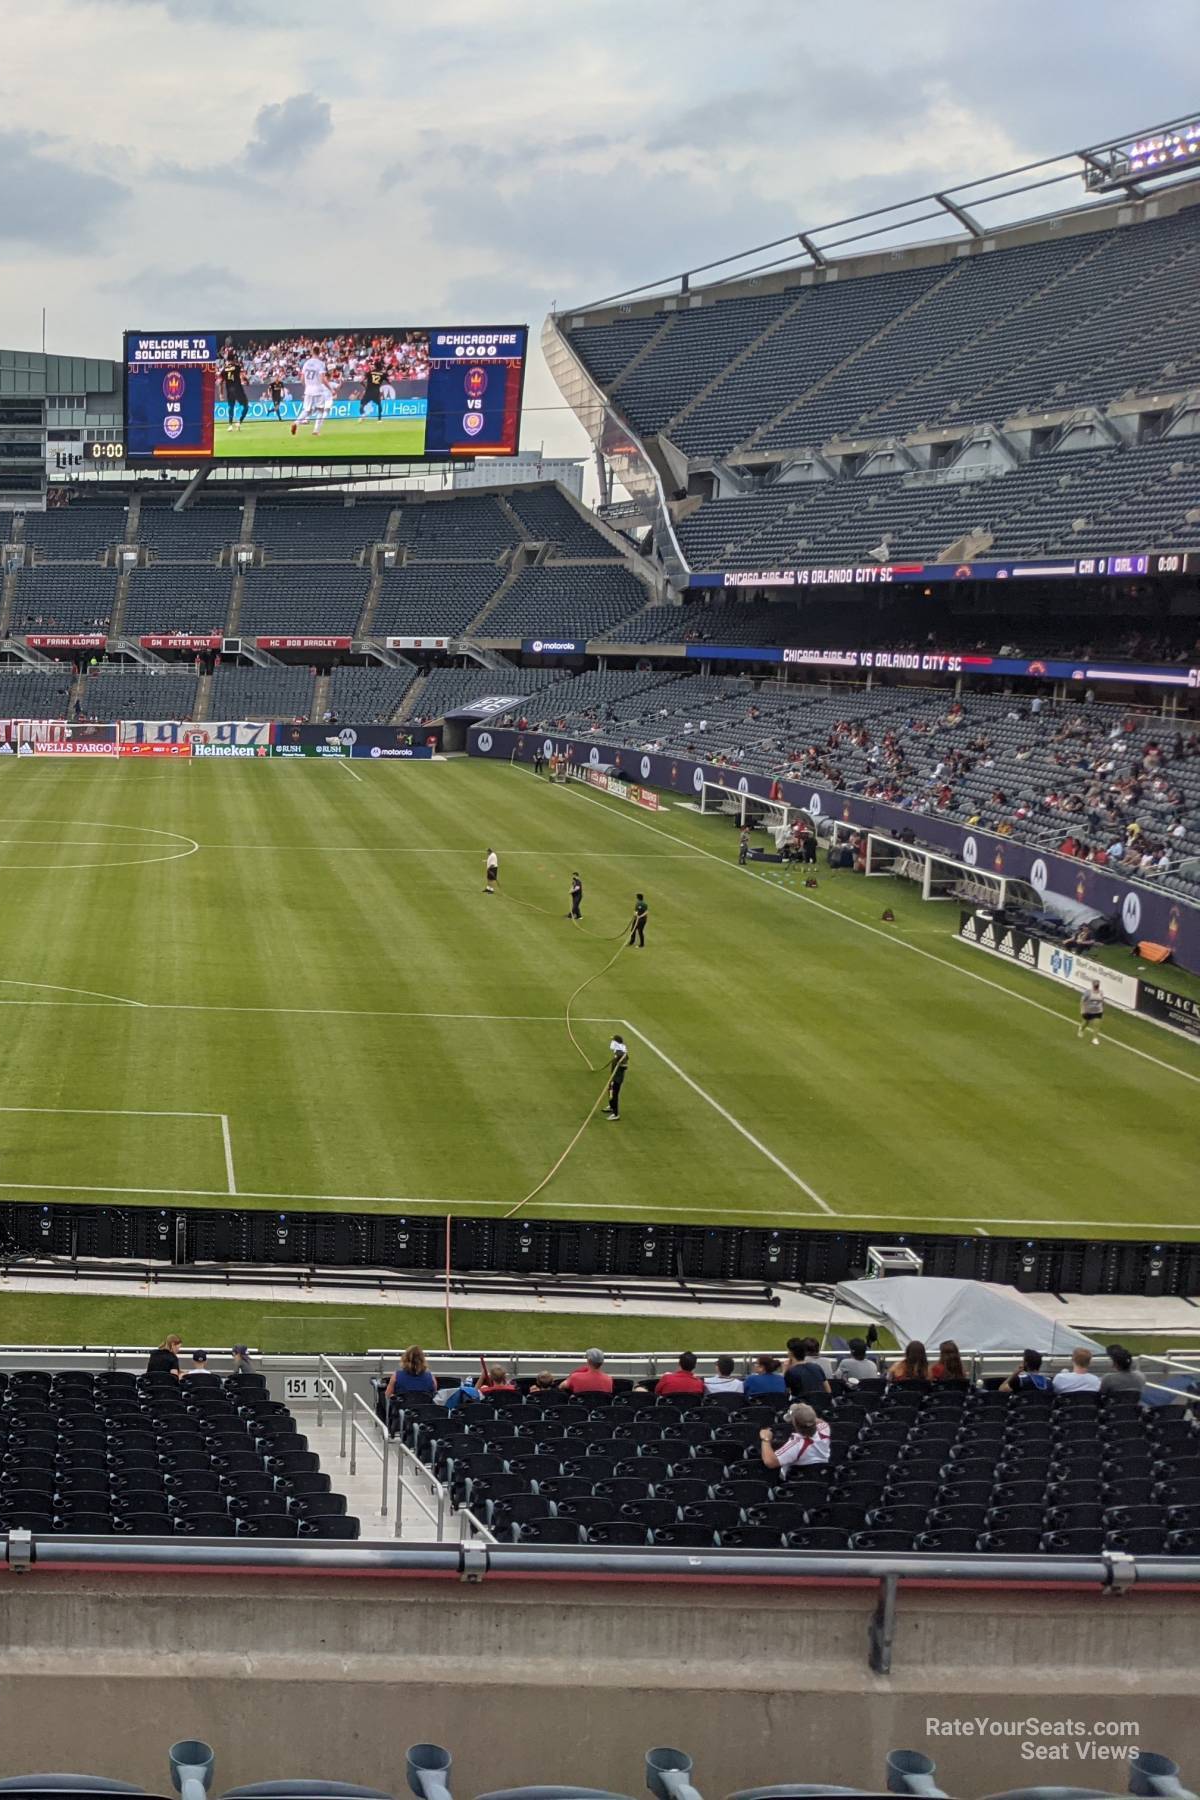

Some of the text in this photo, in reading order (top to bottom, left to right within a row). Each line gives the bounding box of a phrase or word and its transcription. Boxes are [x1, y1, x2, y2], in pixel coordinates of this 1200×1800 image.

[139, 339, 206, 349] WELCOME TO
[437, 334, 517, 345] @CHICAGOFIRE
[135, 350, 209, 360] SOLDIER FIELD
[166, 403, 180, 412] VS
[248, 402, 287, 417] COVD
[467, 399, 482, 409] VS
[93, 444, 123, 457] 0:00
[56, 452, 82, 469] Lite
[1079, 559, 1106, 574] CHI 0
[1114, 557, 1144, 572] ORL 0
[1158, 556, 1178, 571] 0:00
[797, 573, 809, 584] VS
[811, 569, 851, 583] ORLANDO
[856, 568, 877, 582] CITY
[880, 567, 892, 582] SC
[543, 642, 575, 650] motorola
[860, 653, 872, 667] VS
[875, 653, 919, 669] ORLANDO
[922, 655, 945, 670] CITY
[948, 656, 962, 671] SC
[36, 743, 73, 753] WELLS
[75, 743, 112, 753] FARGO
[195, 744, 255, 757] Heineken
[1018, 952, 1036, 965] adidas
[287, 1379, 307, 1393] 151
